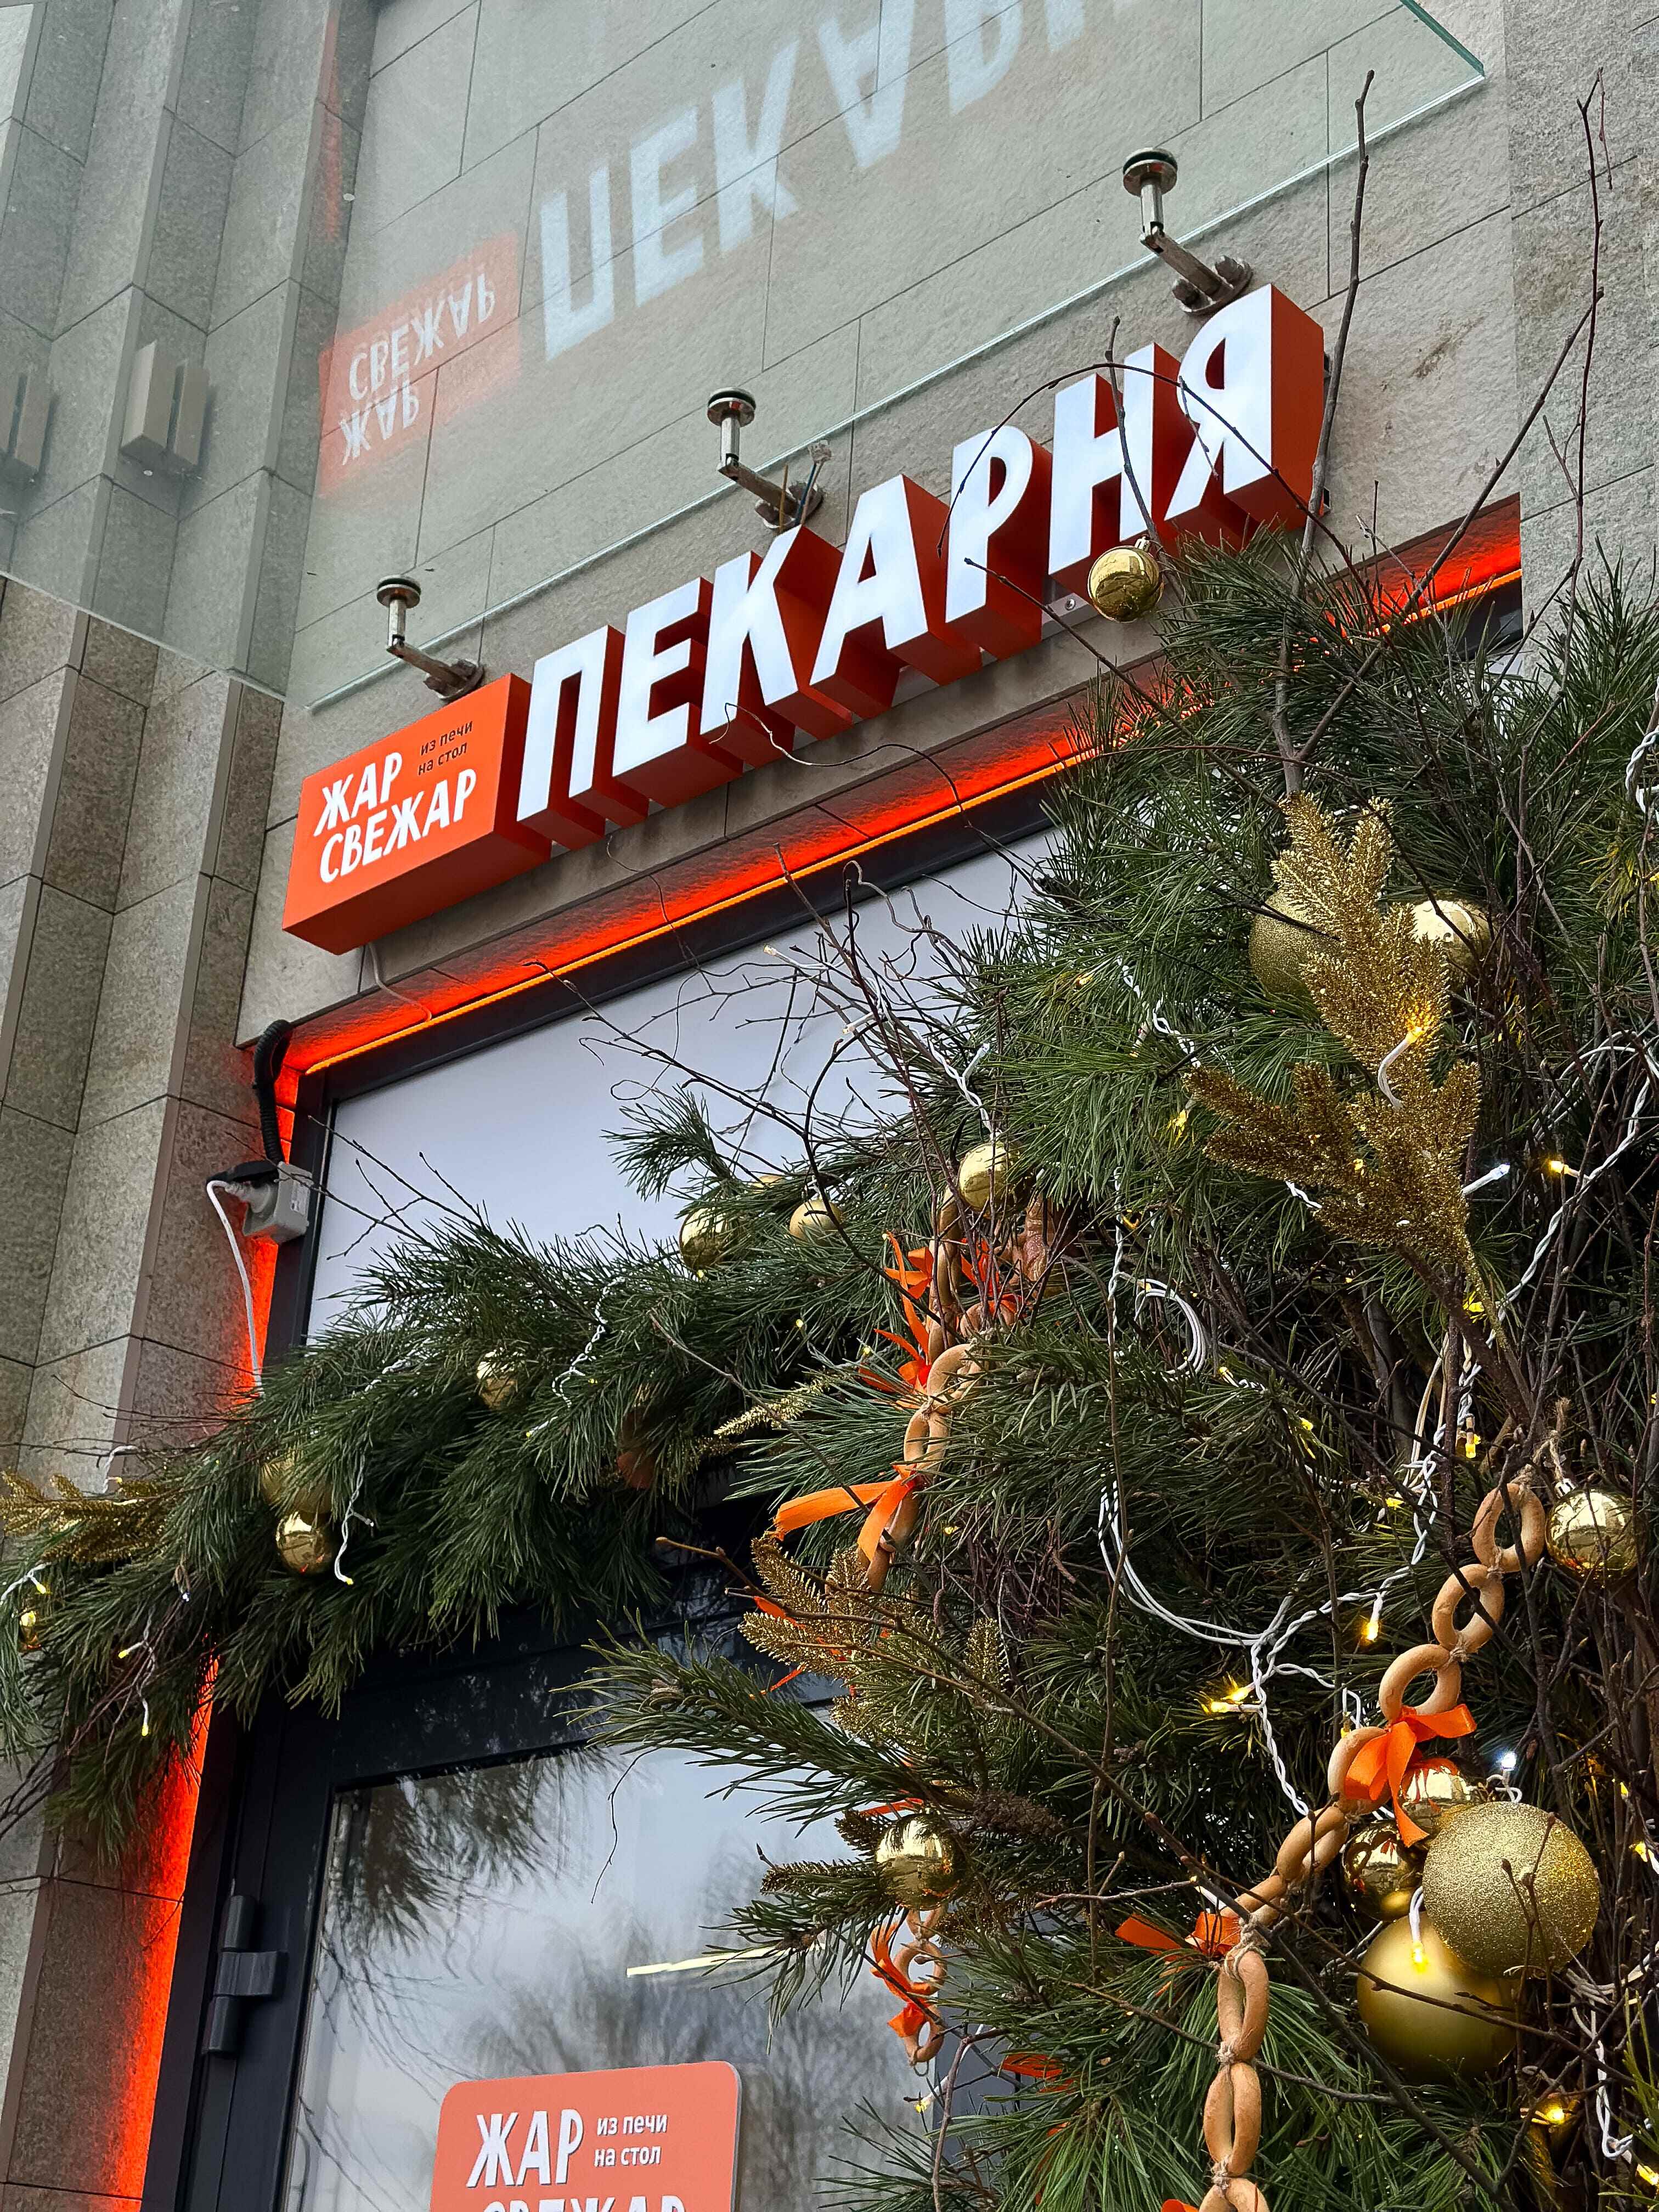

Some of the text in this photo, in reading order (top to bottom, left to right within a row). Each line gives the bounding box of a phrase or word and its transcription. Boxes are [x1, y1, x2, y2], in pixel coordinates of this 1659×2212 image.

[517, 283, 1273, 822] ПЕКАРНЯ
[419, 742, 467, 776] на стол
[421, 721, 473, 756] из печи
[313, 752, 402, 838] ЖАР
[320, 768, 477, 884] СВЕЖАР
[465, 2109, 668, 2188] ЖАР из печи
[594, 2145, 661, 2168] на стол
